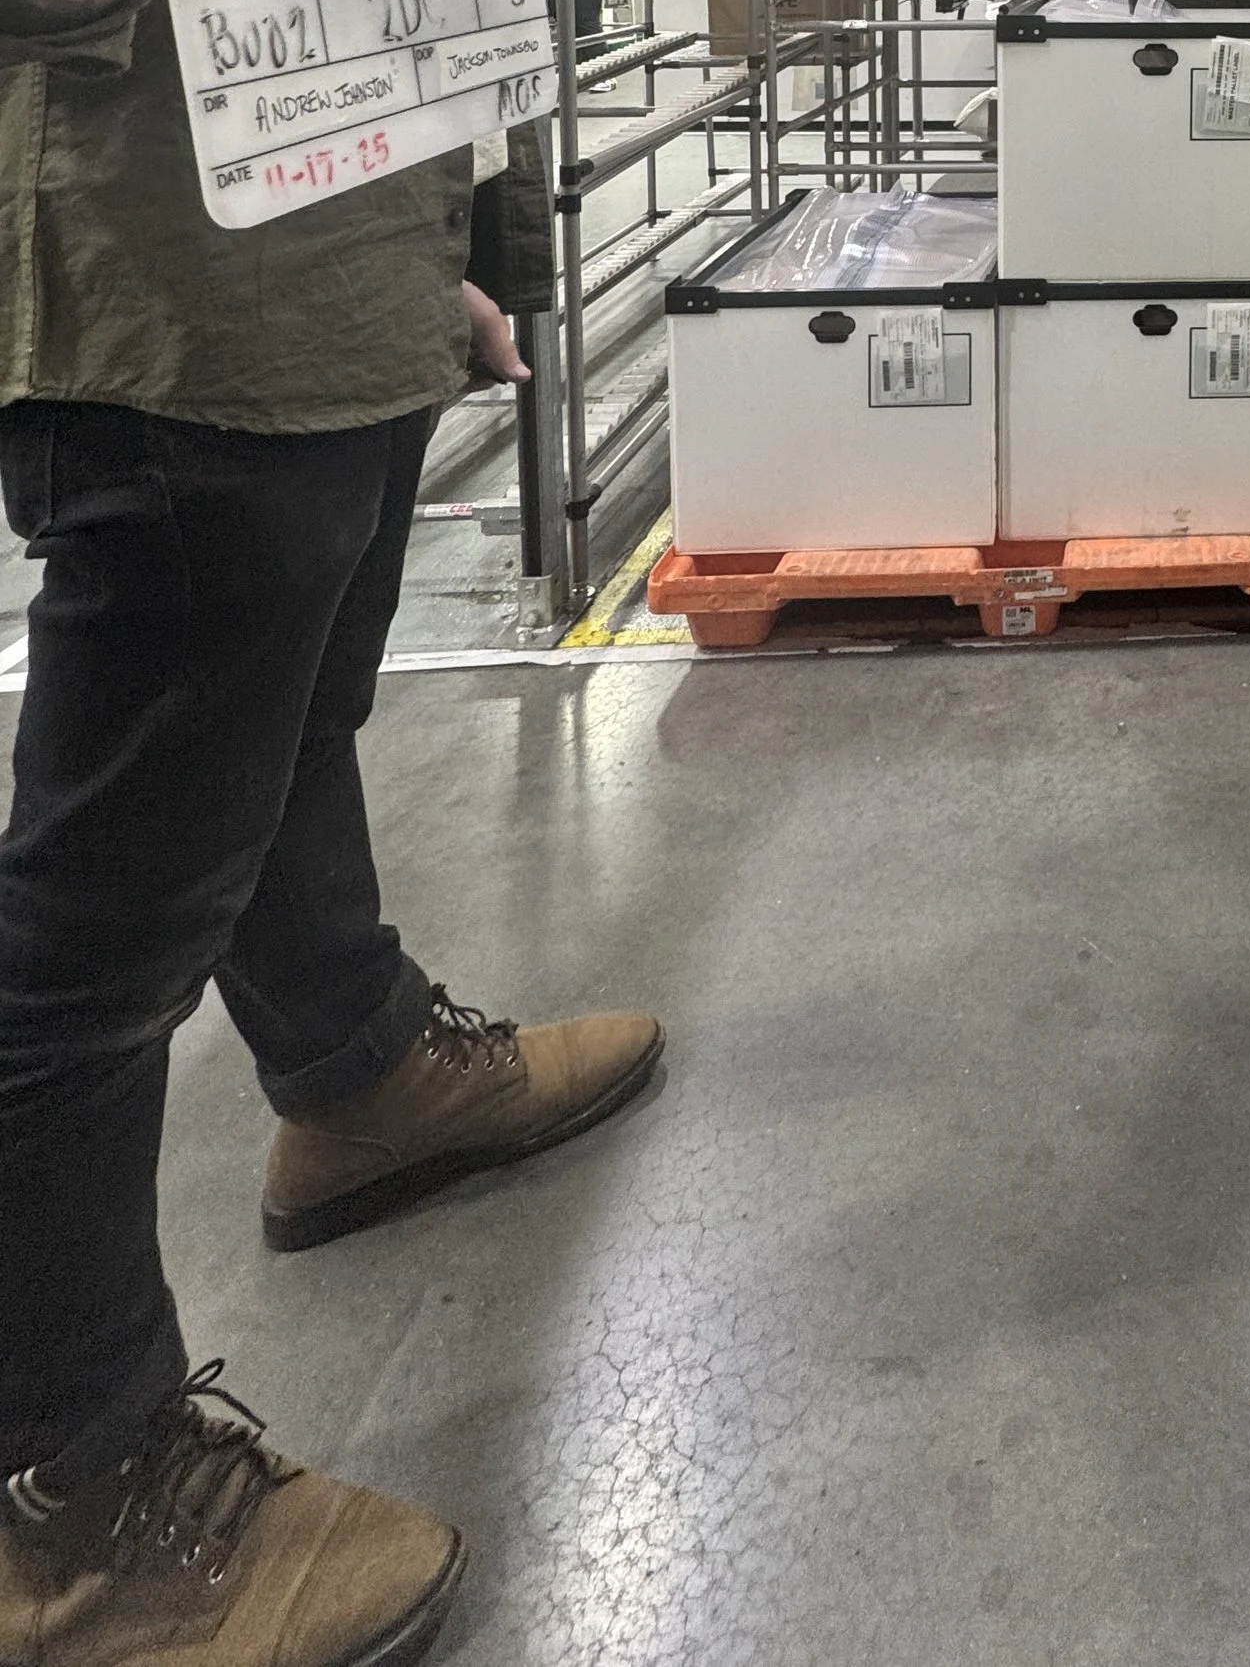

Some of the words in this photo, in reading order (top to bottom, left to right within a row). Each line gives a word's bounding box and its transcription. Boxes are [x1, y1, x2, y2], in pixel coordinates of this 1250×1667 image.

[203, 94, 228, 113] DIR
[255, 89, 332, 133] ANDREW
[333, 73, 395, 110] JOHNSTON
[216, 165, 254, 189] DATE
